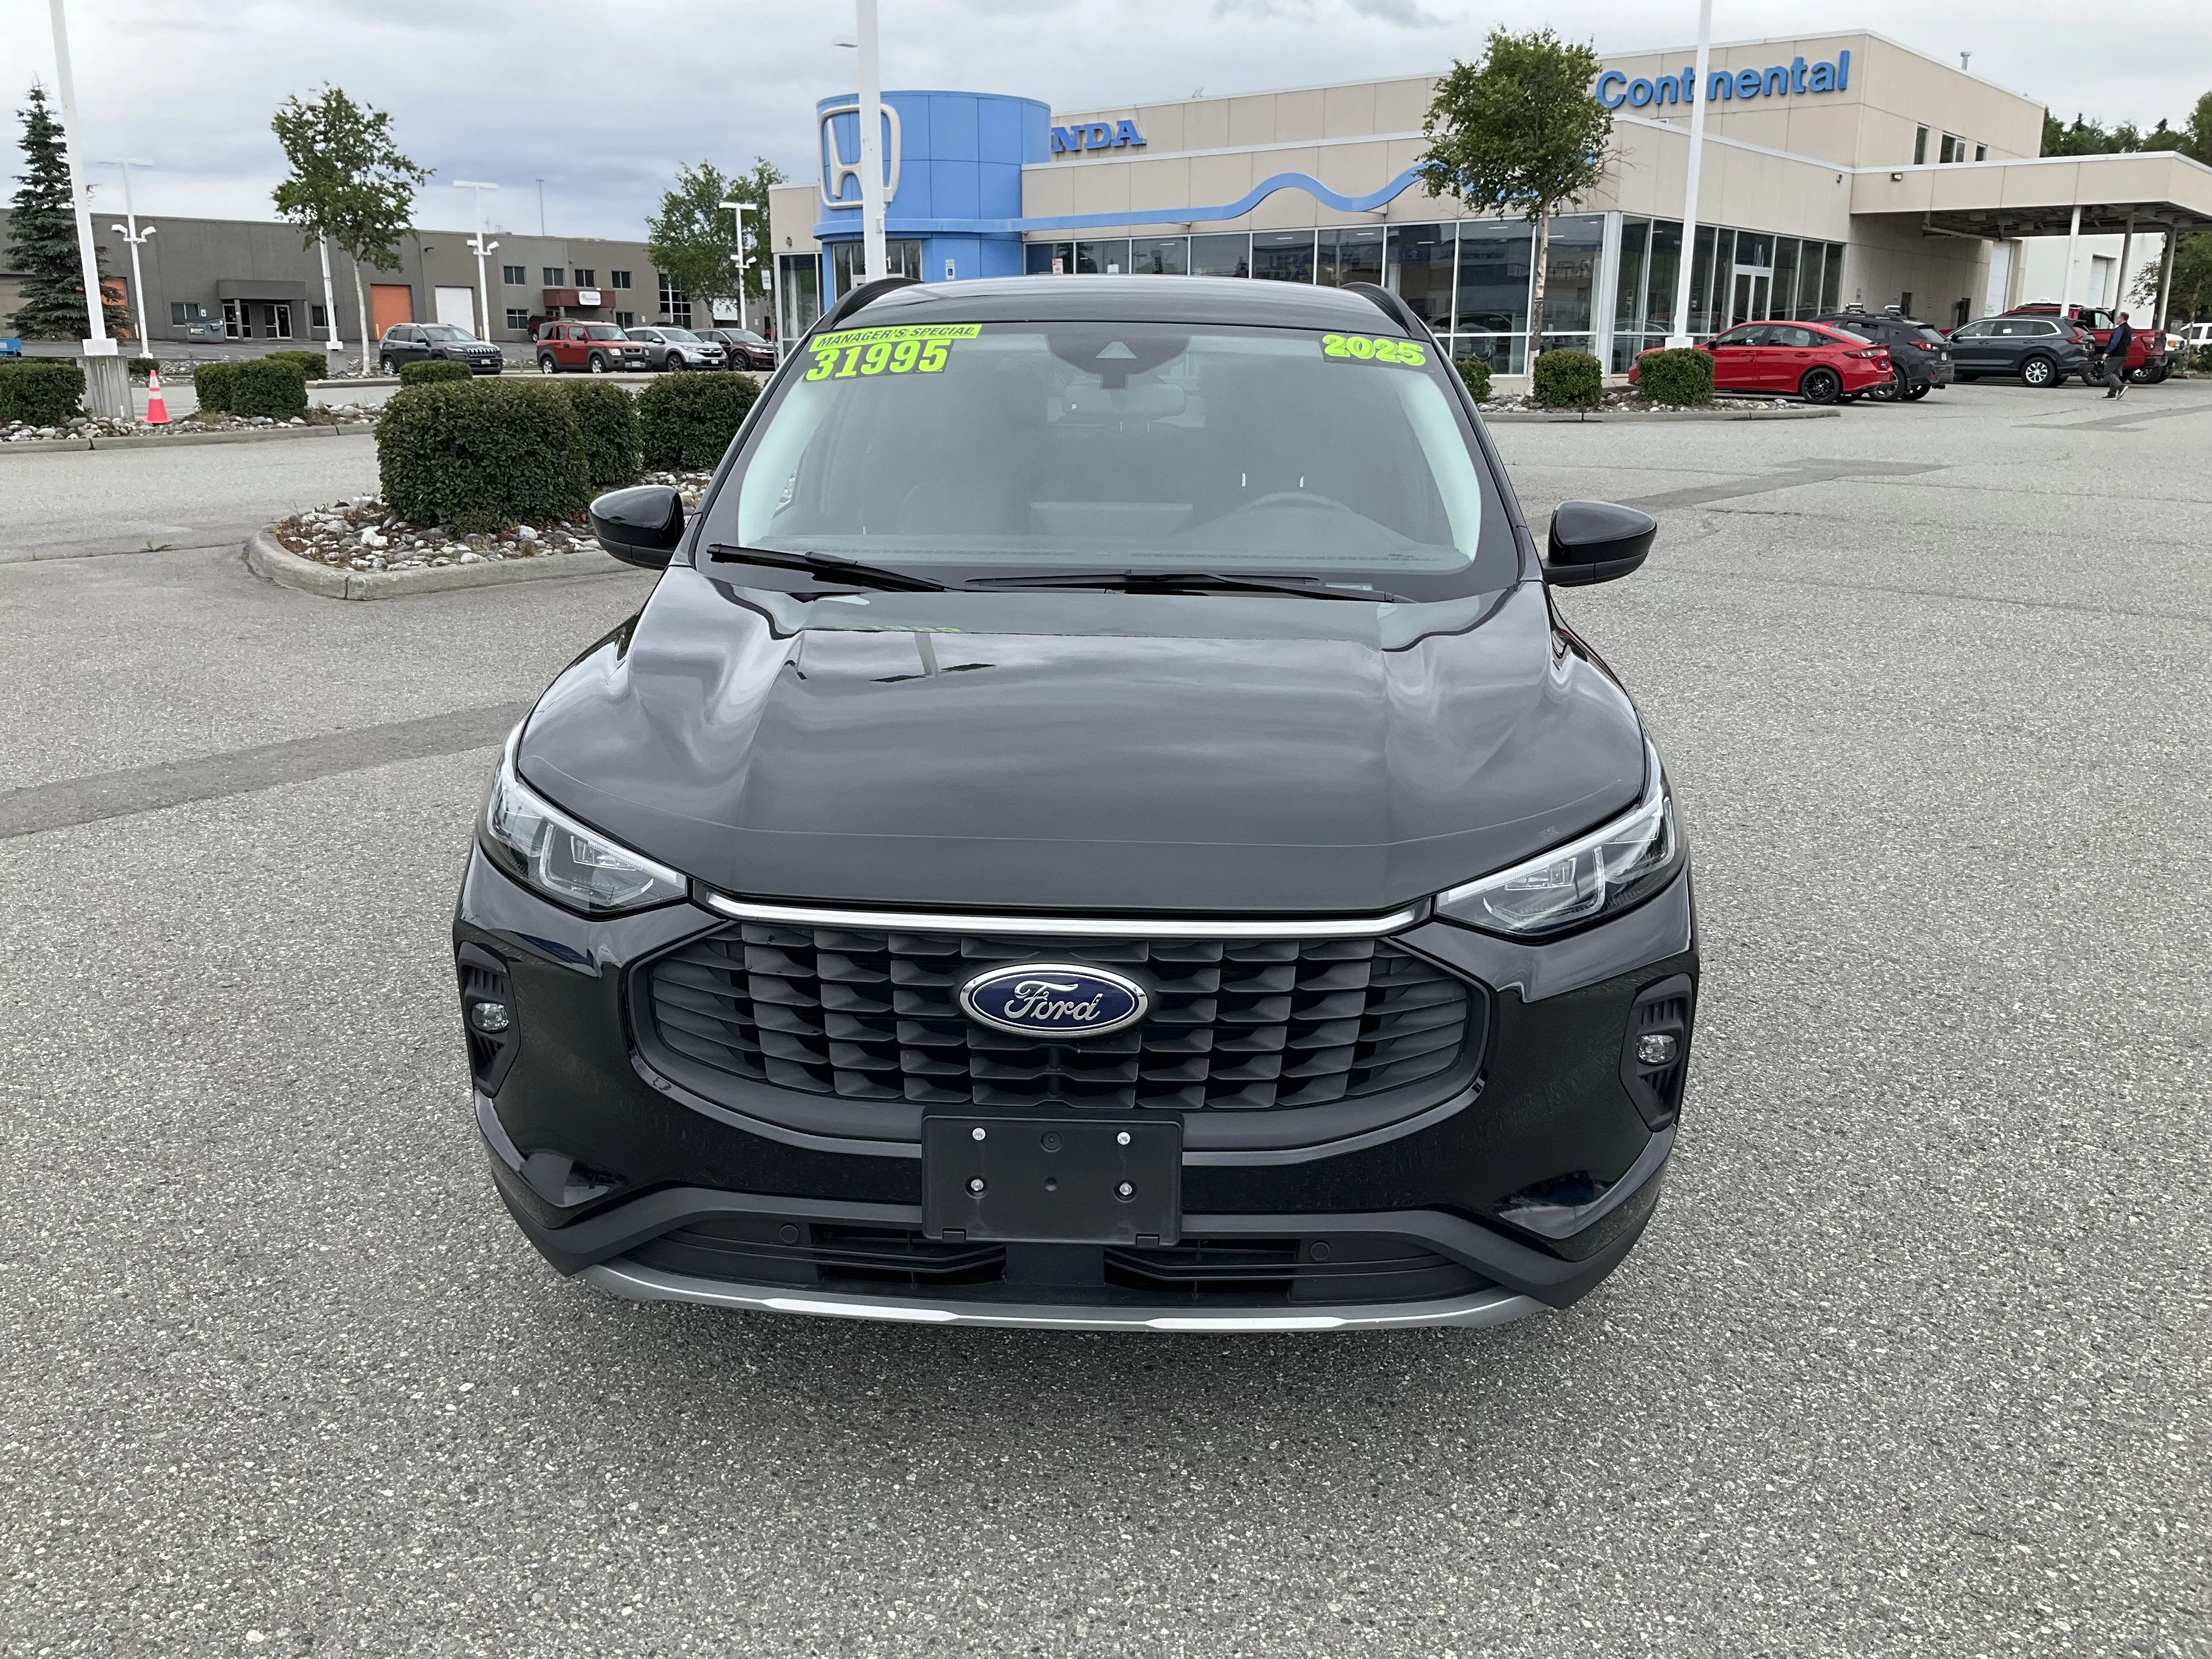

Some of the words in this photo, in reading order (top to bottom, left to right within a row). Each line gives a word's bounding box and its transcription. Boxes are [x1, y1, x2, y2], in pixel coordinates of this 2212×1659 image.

[1595, 50, 1850, 109] Contnental
[1051, 119, 1146, 152] NDA
[816, 328, 909, 348] MANAGER'S
[911, 326, 975, 337] SPECIAL
[1322, 335, 1425, 366] 2025
[806, 340, 952, 380] 31995
[1004, 980, 1103, 1021] Ford
